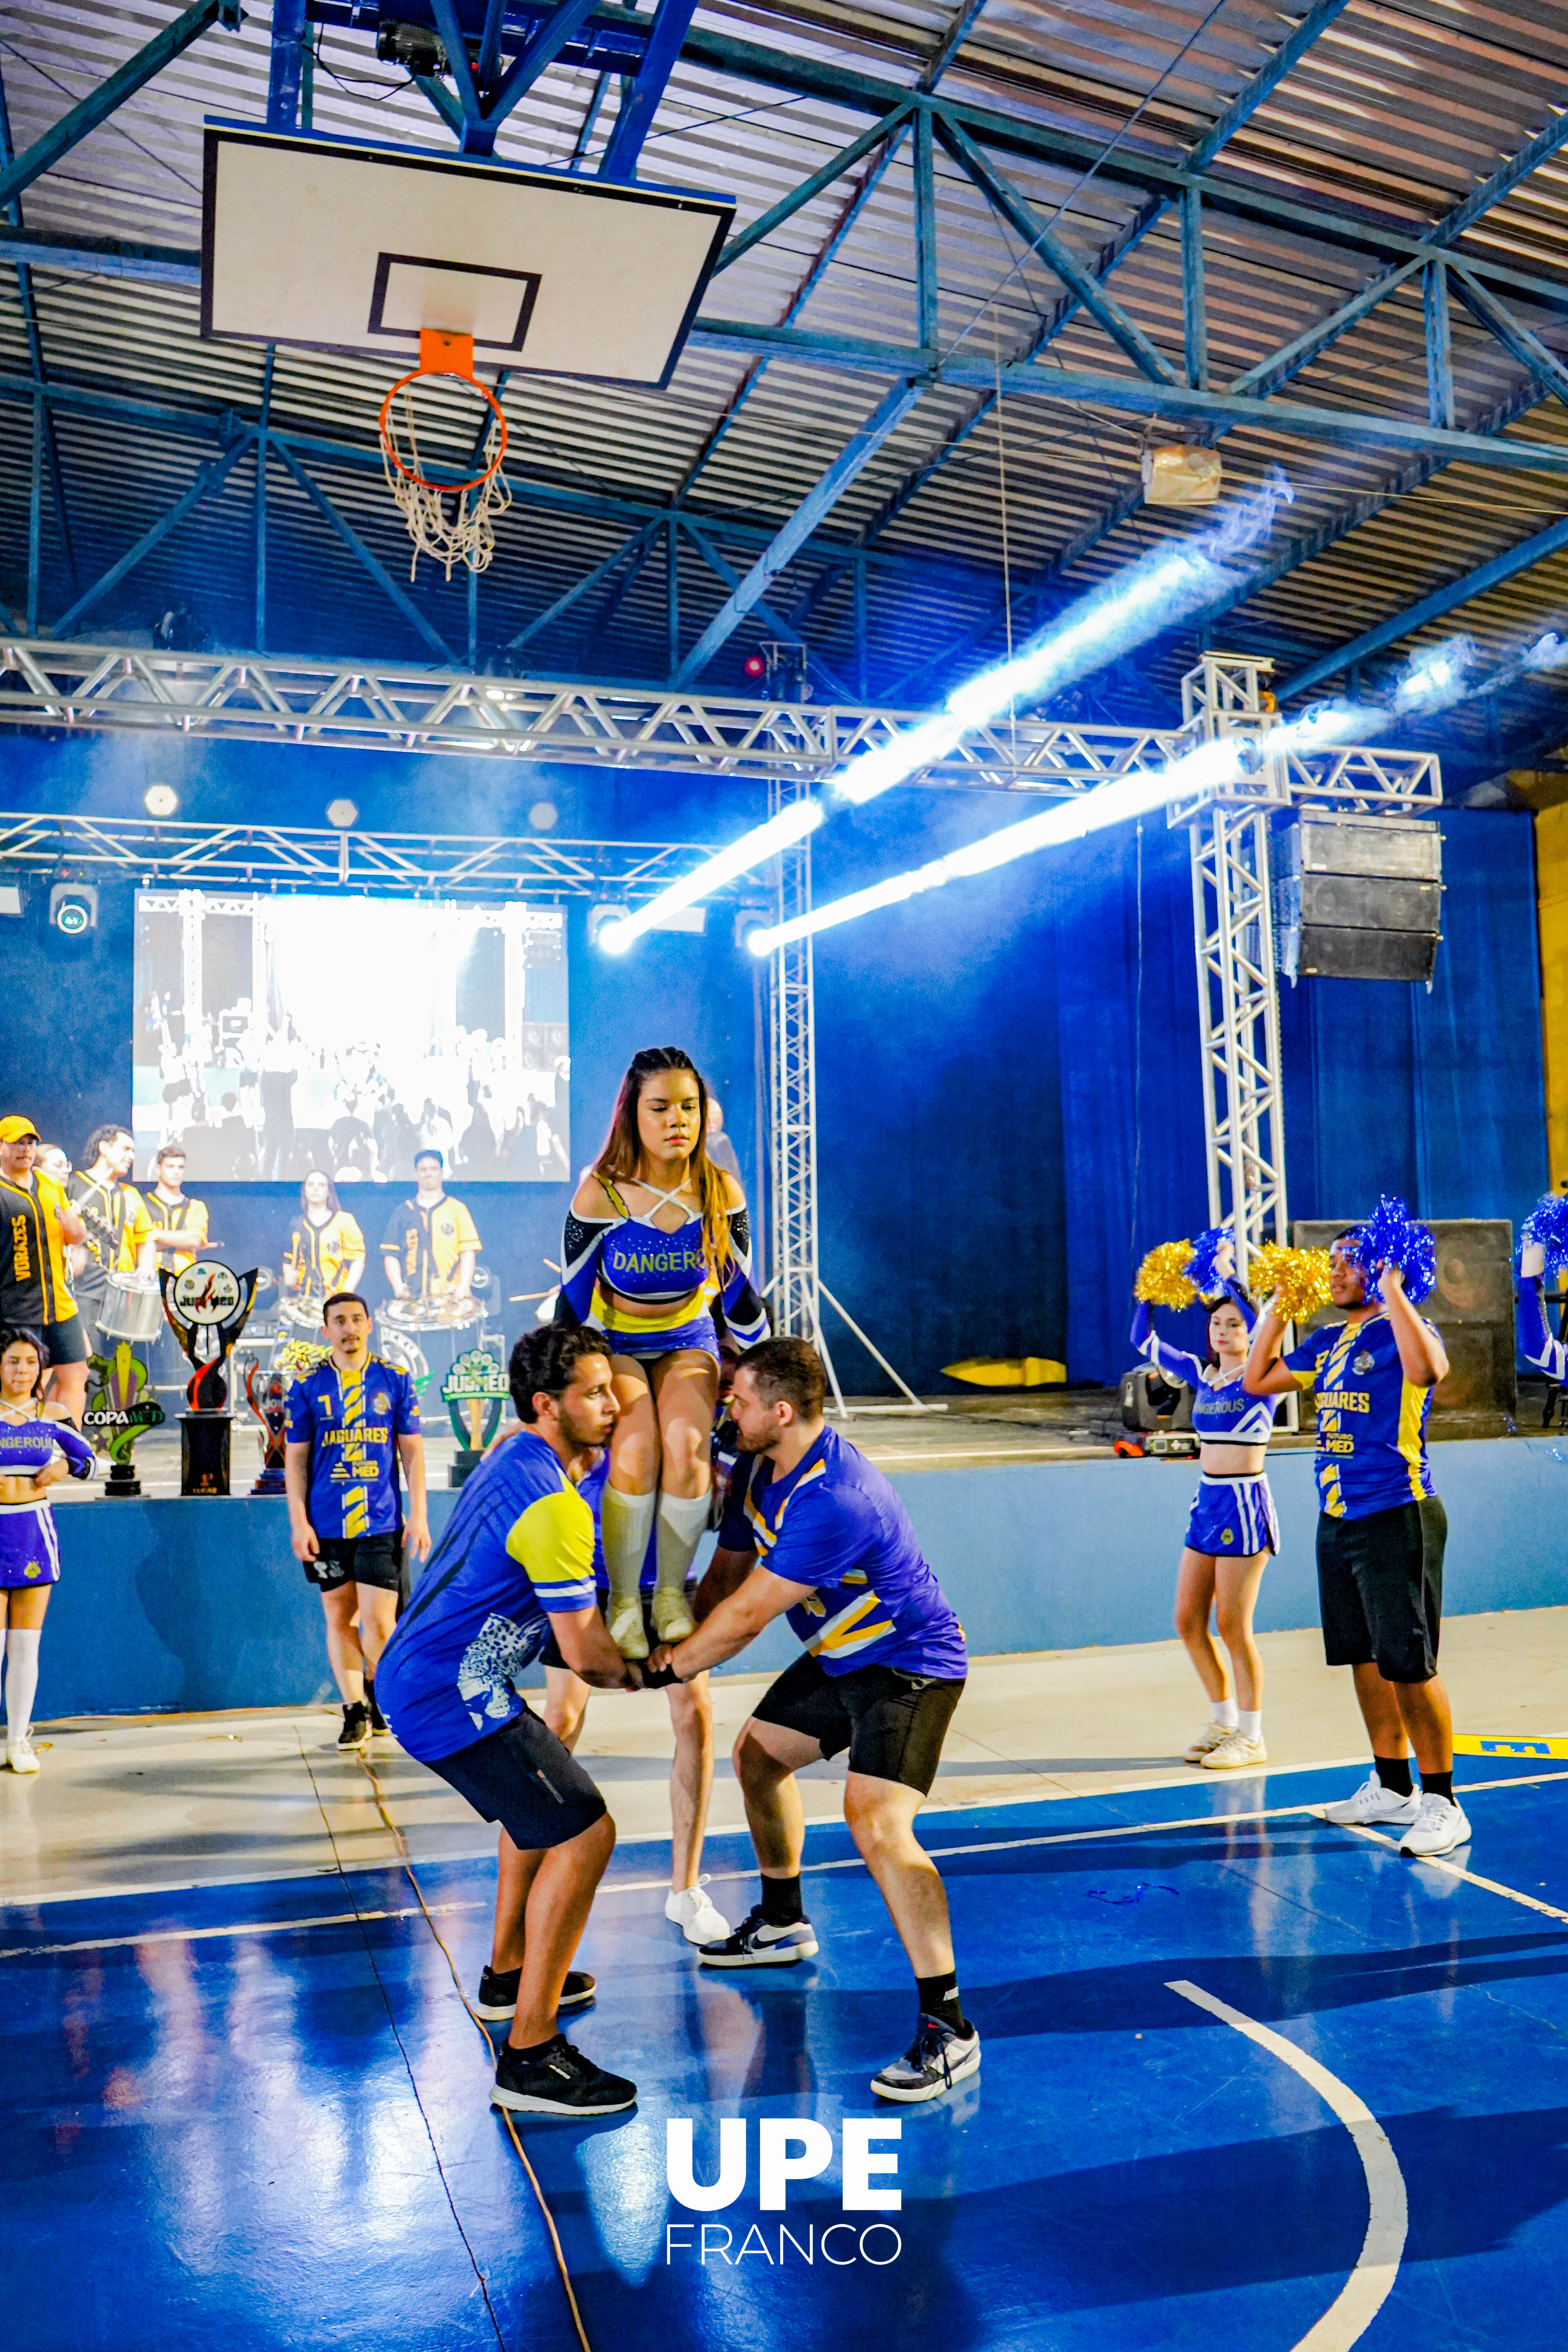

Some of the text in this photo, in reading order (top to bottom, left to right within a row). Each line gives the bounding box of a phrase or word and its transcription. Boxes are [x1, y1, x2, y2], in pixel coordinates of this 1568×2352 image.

[321, 1427, 388, 1447] JAGUARES
[1326, 1439, 1354, 1453] MED
[352, 1466, 379, 1477] MED
